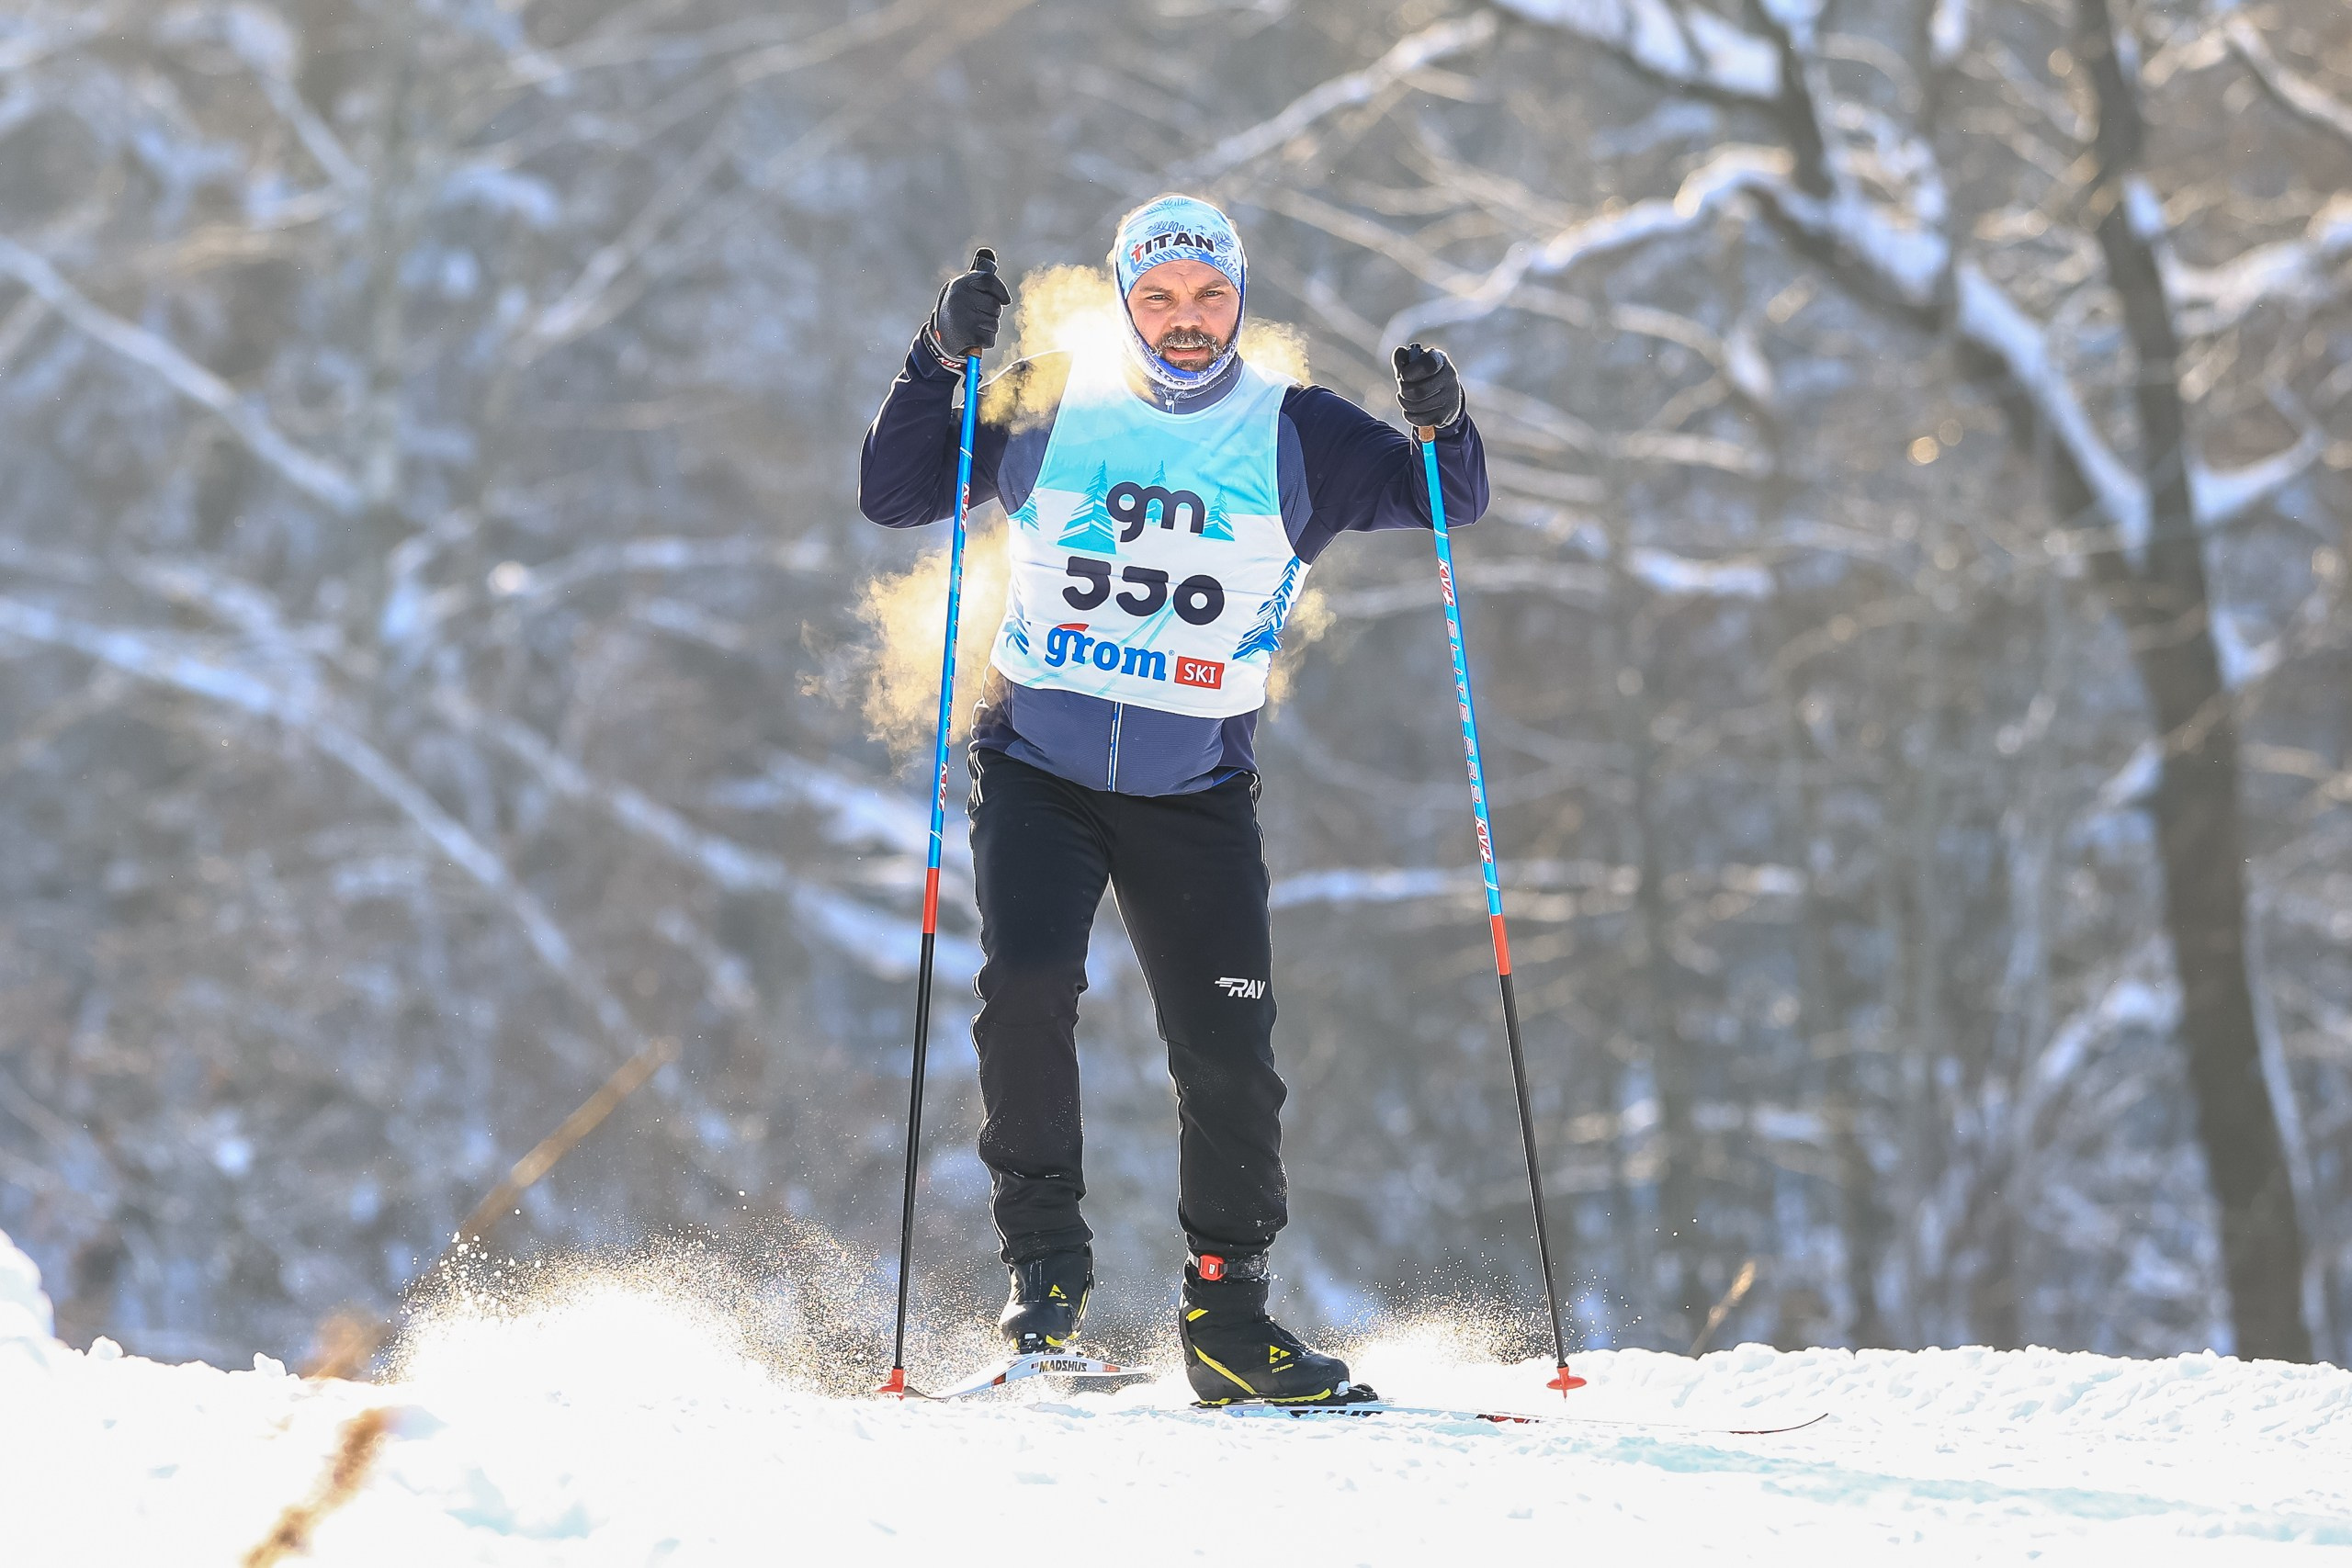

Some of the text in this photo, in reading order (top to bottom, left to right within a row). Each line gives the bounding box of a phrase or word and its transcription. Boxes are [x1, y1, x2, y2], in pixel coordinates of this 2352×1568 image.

[1131, 232, 1215, 263] TITAN
[1106, 481, 1205, 543] gm
[1045, 625, 1216, 683] grom SKI
[1446, 618, 1469, 723] ELITE
[1038, 1359, 1088, 1373] MADSHUS
